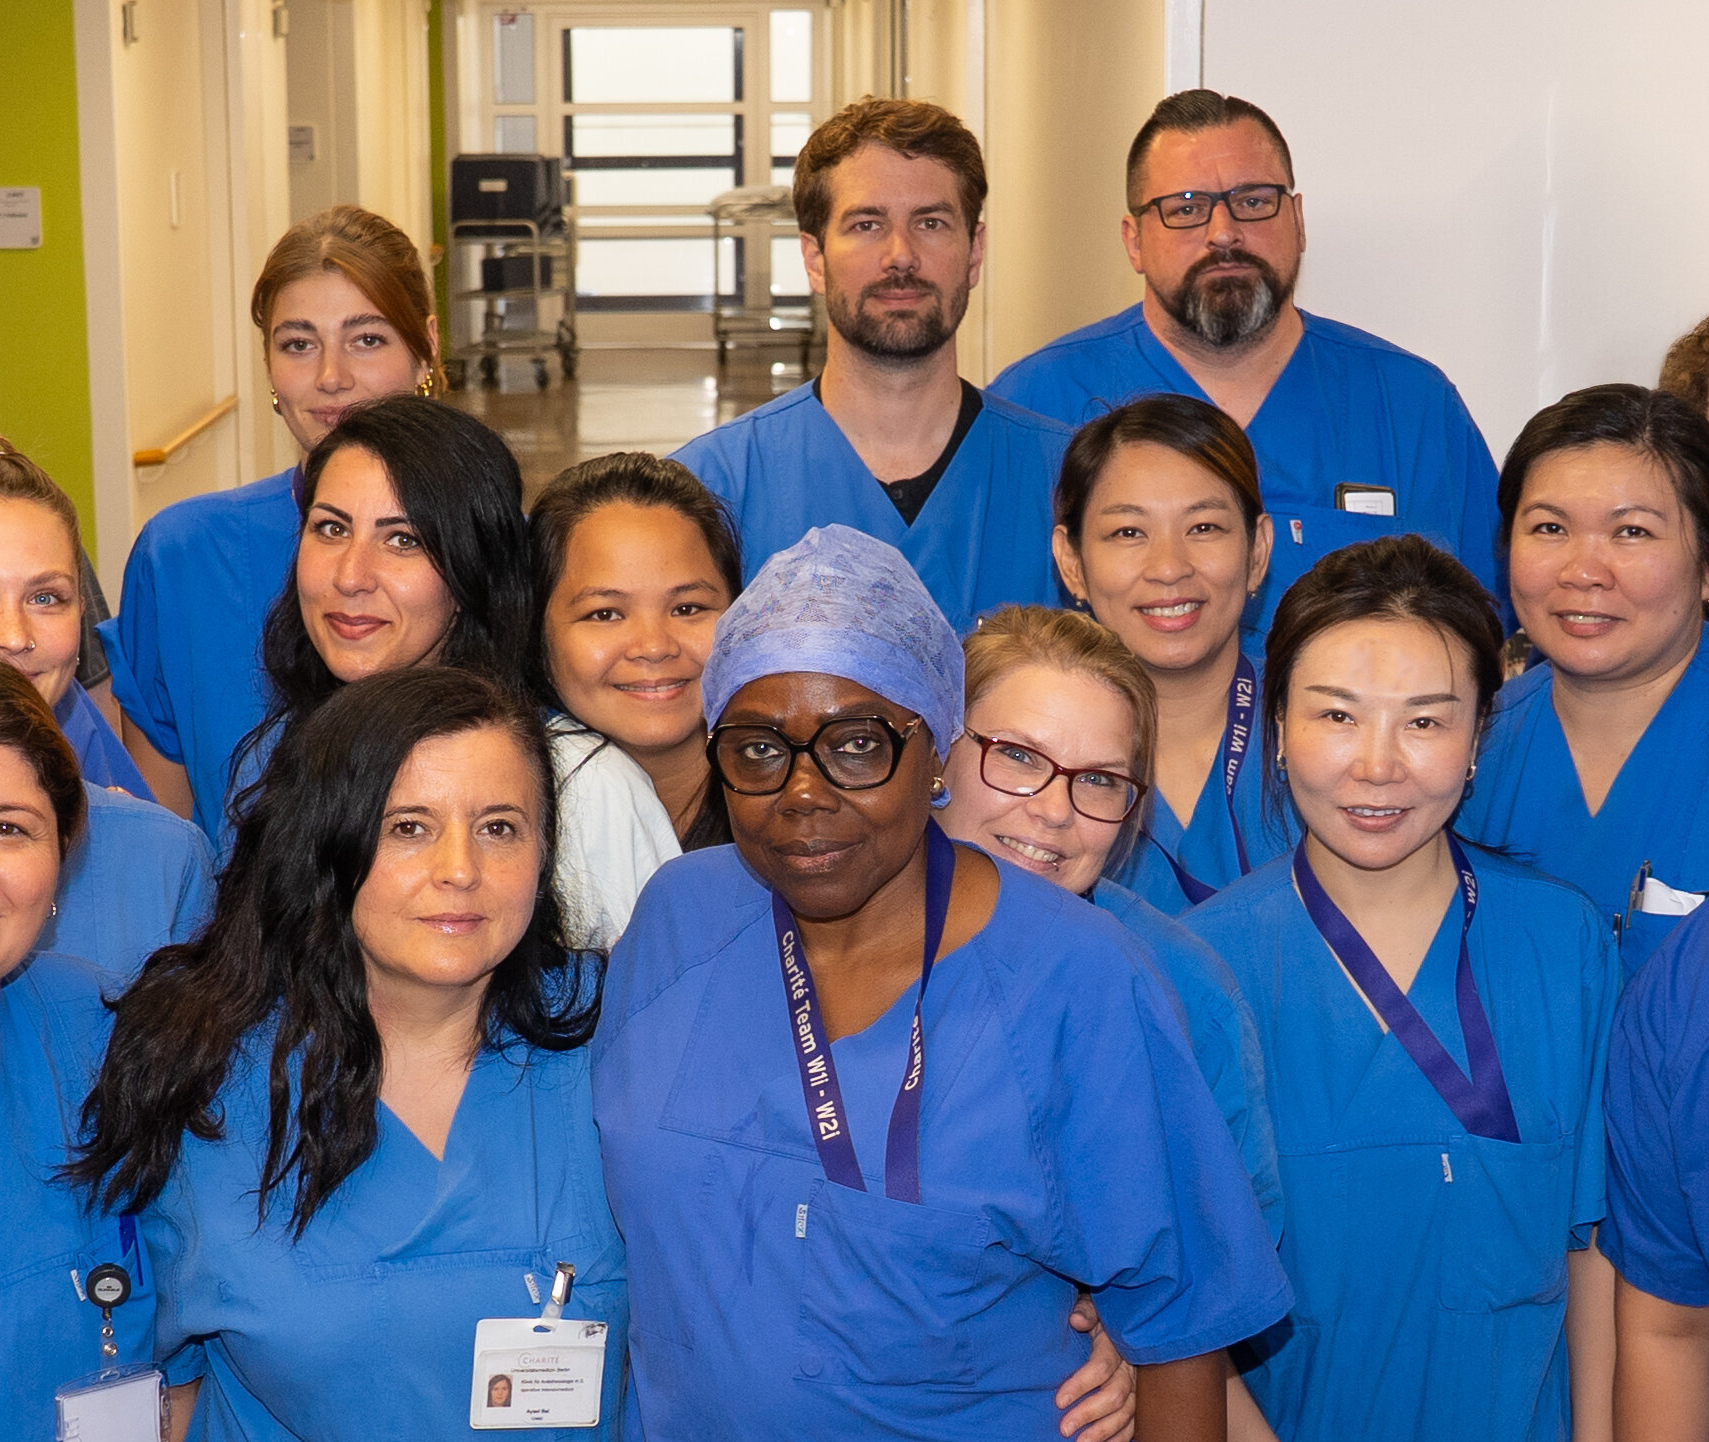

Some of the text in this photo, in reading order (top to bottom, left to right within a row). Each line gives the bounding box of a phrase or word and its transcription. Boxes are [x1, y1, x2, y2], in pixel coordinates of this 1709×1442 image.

[1235, 677, 1253, 708] W2i
[1230, 723, 1248, 753] W1i
[1461, 869, 1476, 905] W2i
[781, 930, 810, 1000] Charité
[794, 1000, 818, 1055] Team
[806, 1055, 830, 1088] W1i
[815, 1101, 842, 1141] W2i
